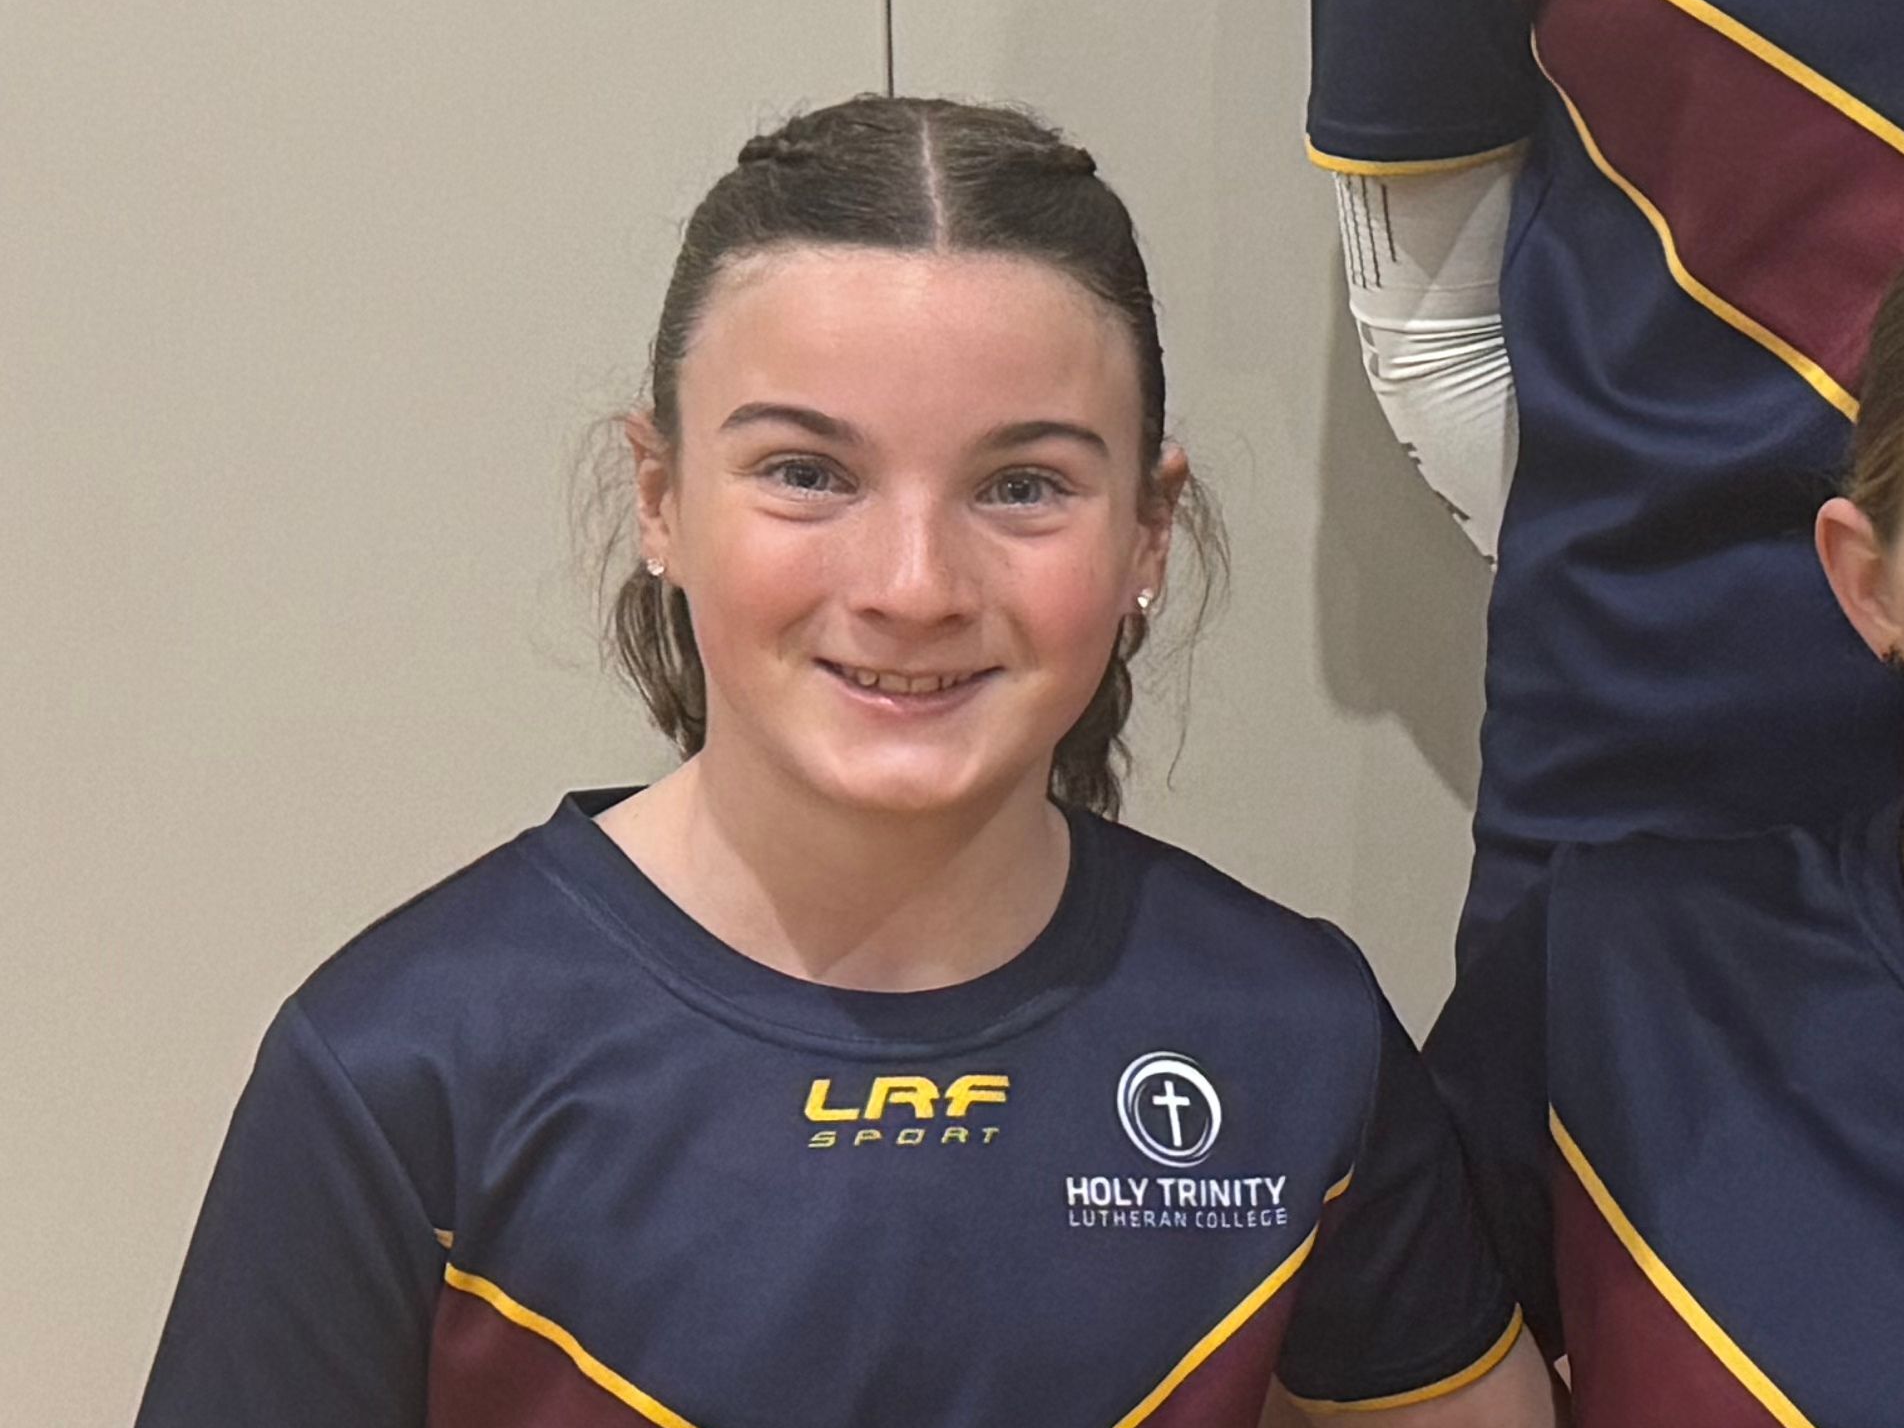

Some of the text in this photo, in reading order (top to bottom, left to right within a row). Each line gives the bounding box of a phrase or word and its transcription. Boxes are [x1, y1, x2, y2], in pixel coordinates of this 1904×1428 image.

[803, 1074, 1011, 1122] LRF
[807, 1125, 1000, 1148] SPORT
[1065, 1175, 1287, 1208] HOLY TRINITY
[1068, 1207, 1288, 1229] LUTHERAN COLLEGE
